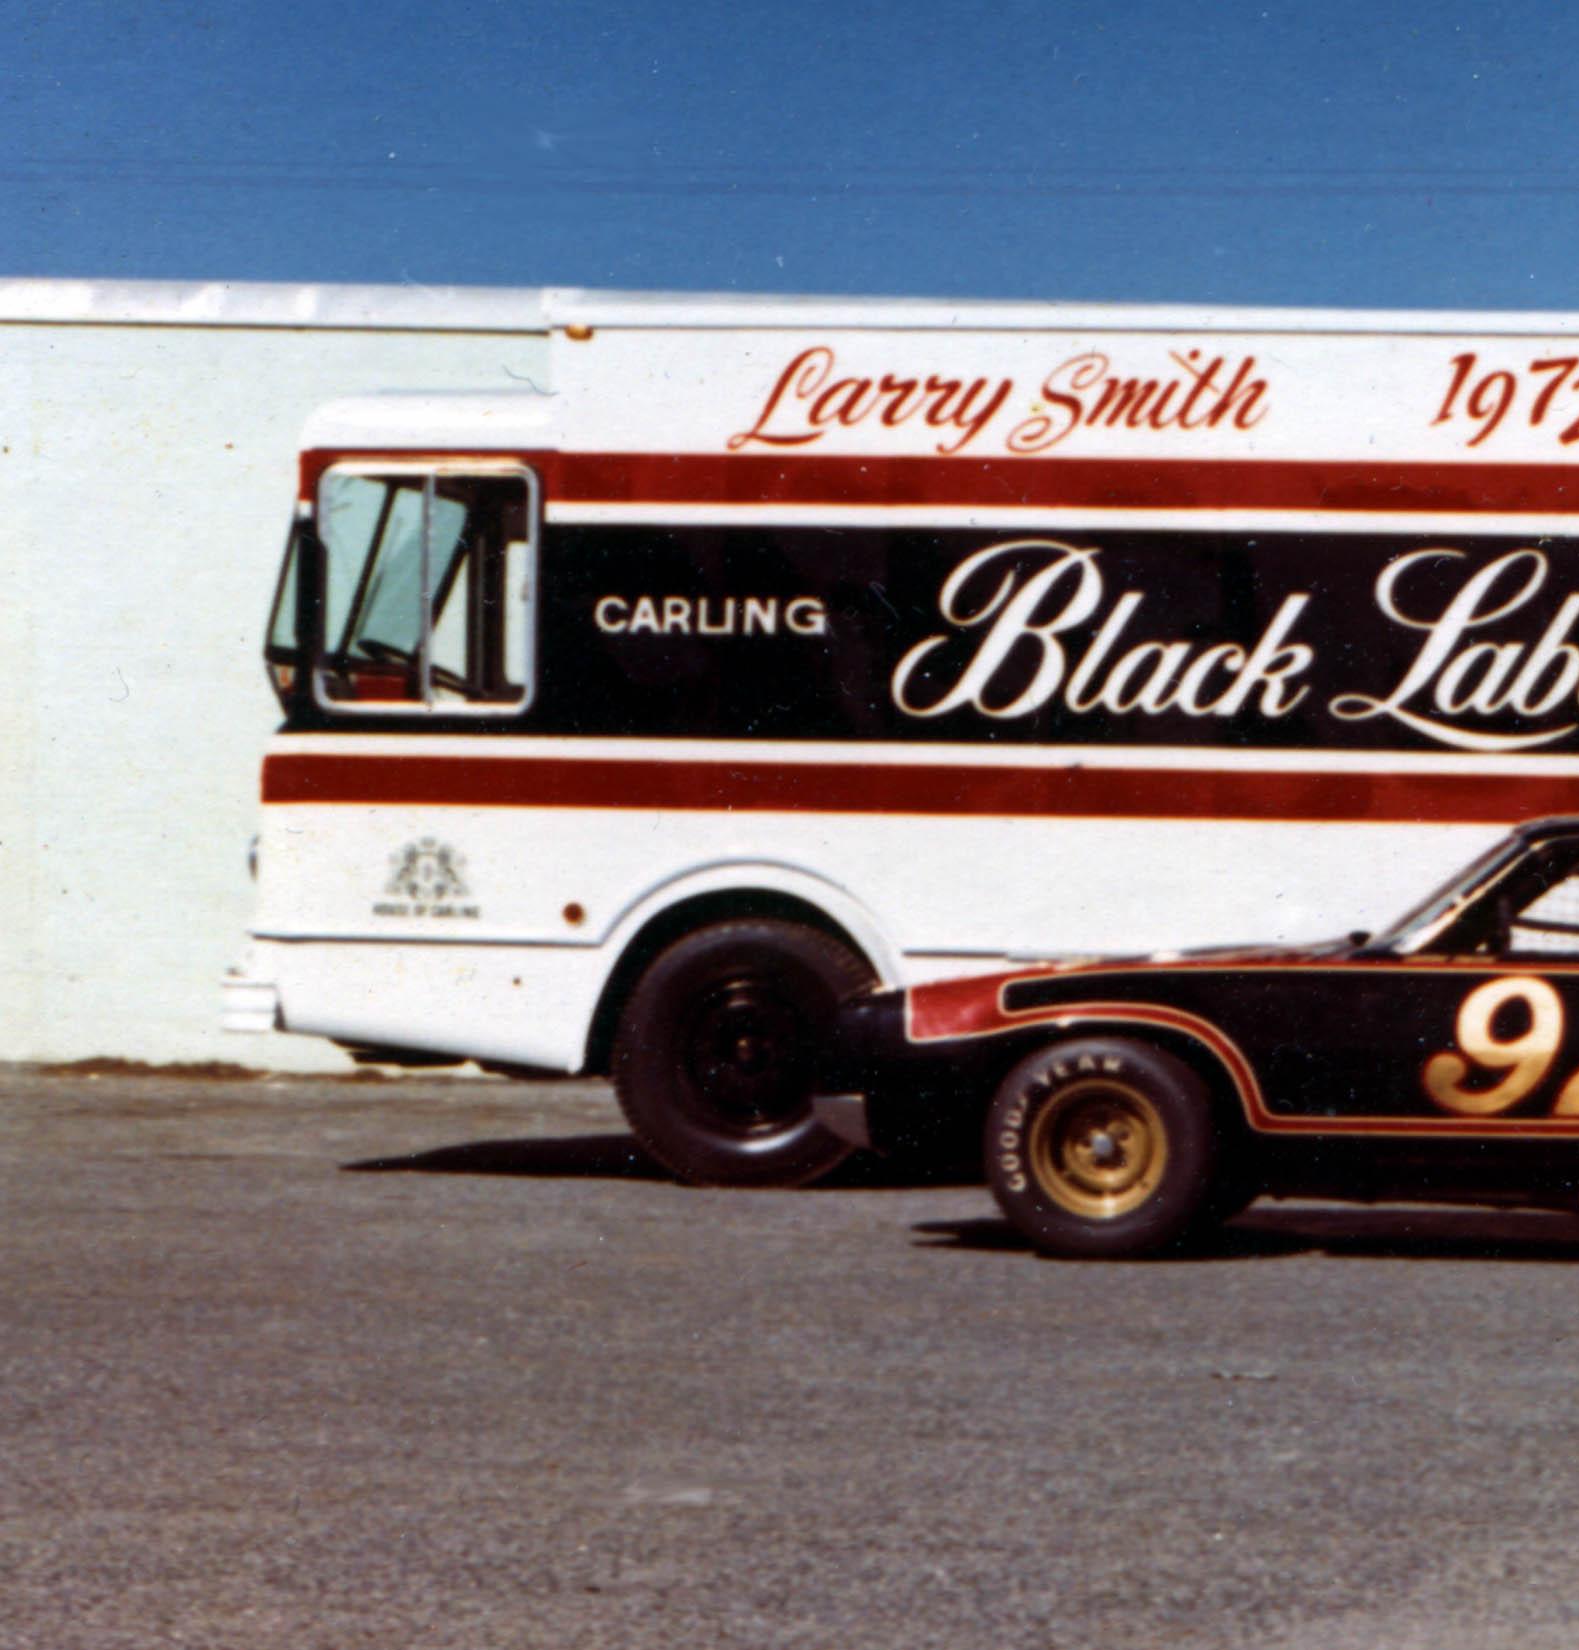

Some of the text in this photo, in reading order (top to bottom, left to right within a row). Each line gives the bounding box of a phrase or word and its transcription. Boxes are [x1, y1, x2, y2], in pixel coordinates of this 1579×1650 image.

[727, 346, 1269, 454] Larry Smith
[594, 596, 828, 637] CARLING
[890, 539, 1315, 721] Black
